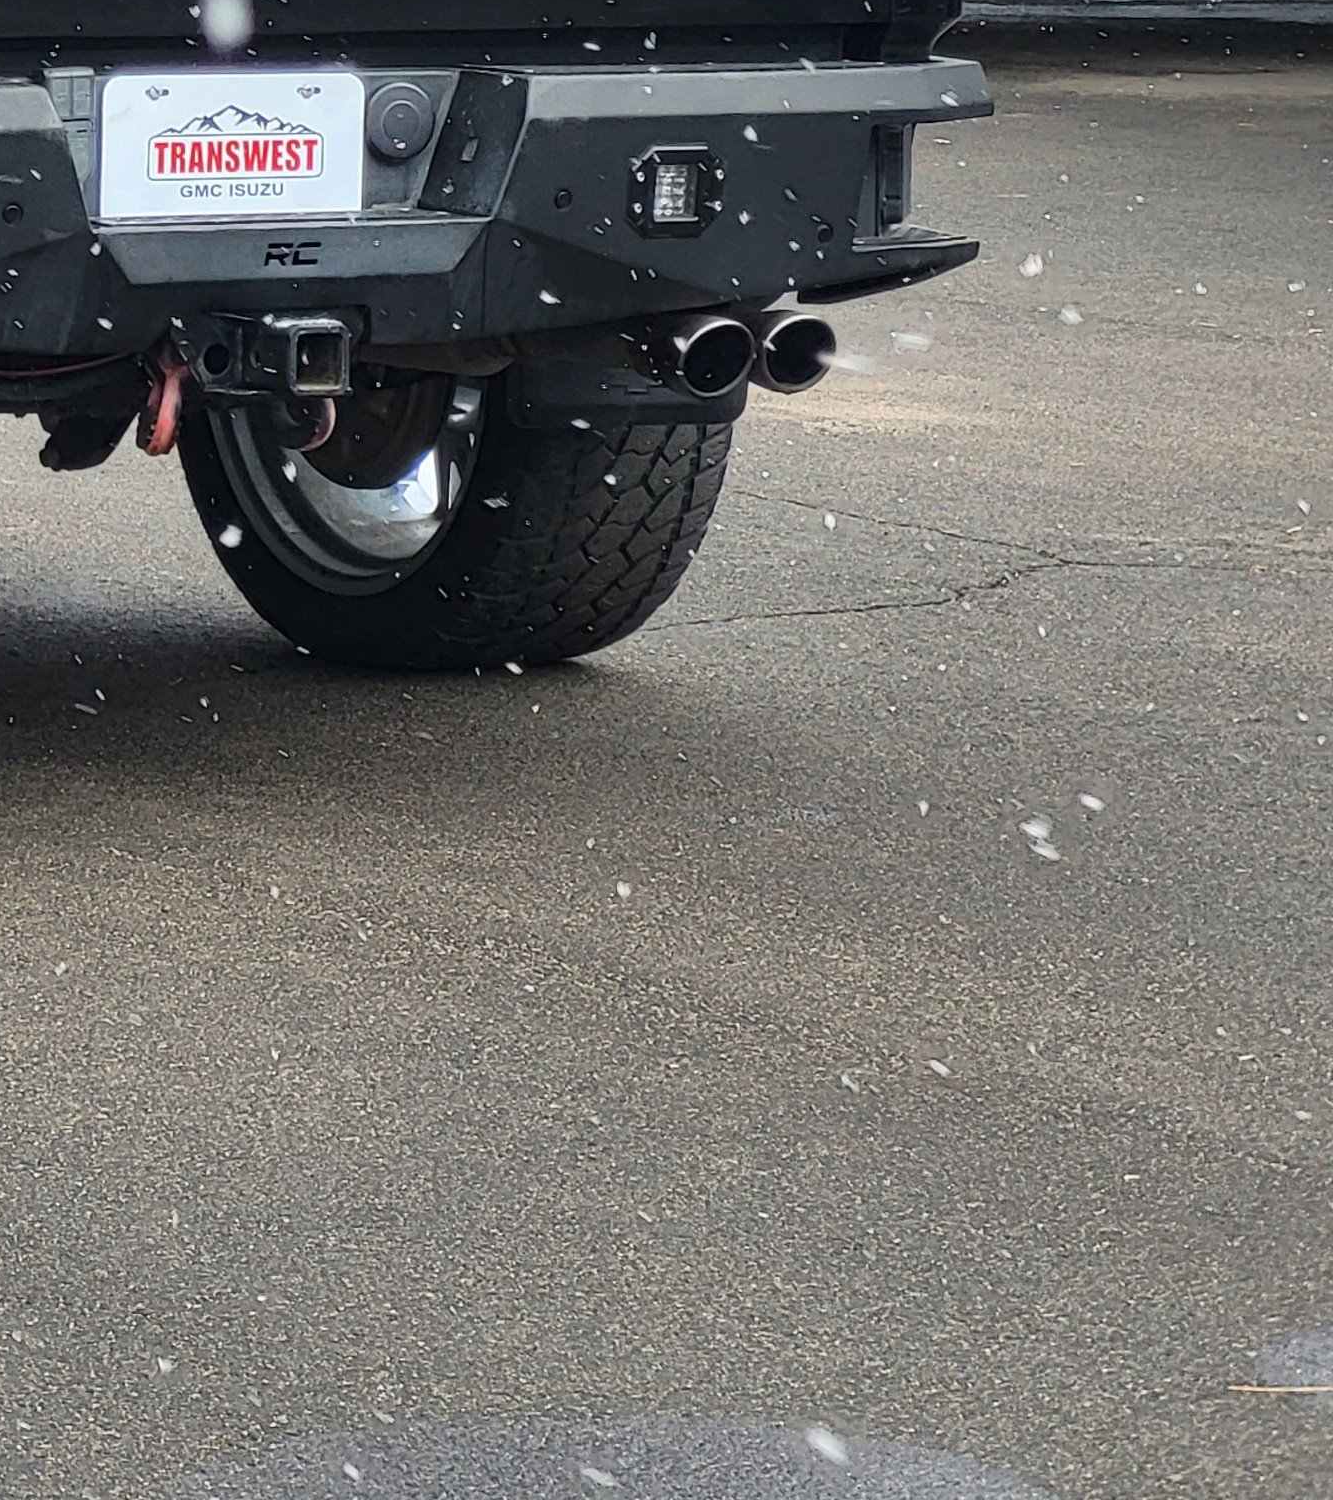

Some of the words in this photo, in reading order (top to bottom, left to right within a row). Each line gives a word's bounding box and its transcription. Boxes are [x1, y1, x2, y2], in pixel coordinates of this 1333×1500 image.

[153, 138, 319, 175] TRANSWEST
[179, 184, 223, 198] GMC
[229, 182, 284, 197] ISUZU
[263, 241, 322, 267] RC
